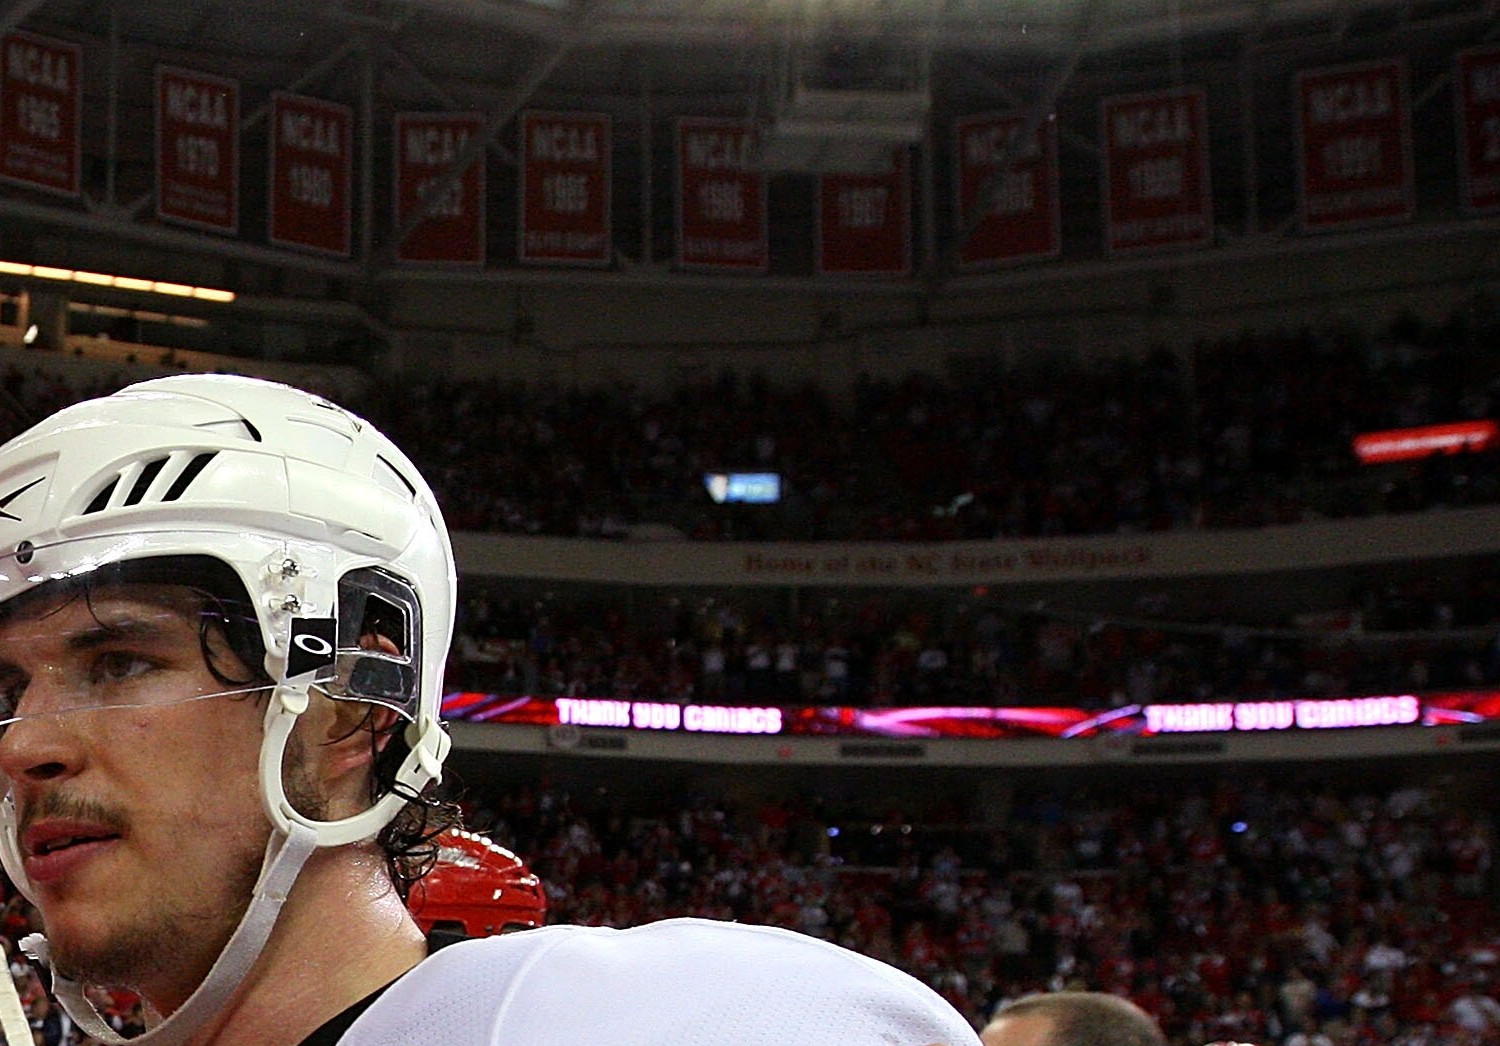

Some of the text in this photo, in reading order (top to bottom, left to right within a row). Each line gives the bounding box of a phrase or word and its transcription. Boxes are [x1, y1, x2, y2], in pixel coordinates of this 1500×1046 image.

[7, 42, 69, 92] NCAA
[167, 80, 228, 129] NCAA
[1309, 78, 1392, 126] NCAA
[281, 111, 341, 156] NCAA
[532, 124, 598, 160] NCAA
[1112, 104, 1191, 147] NCAA
